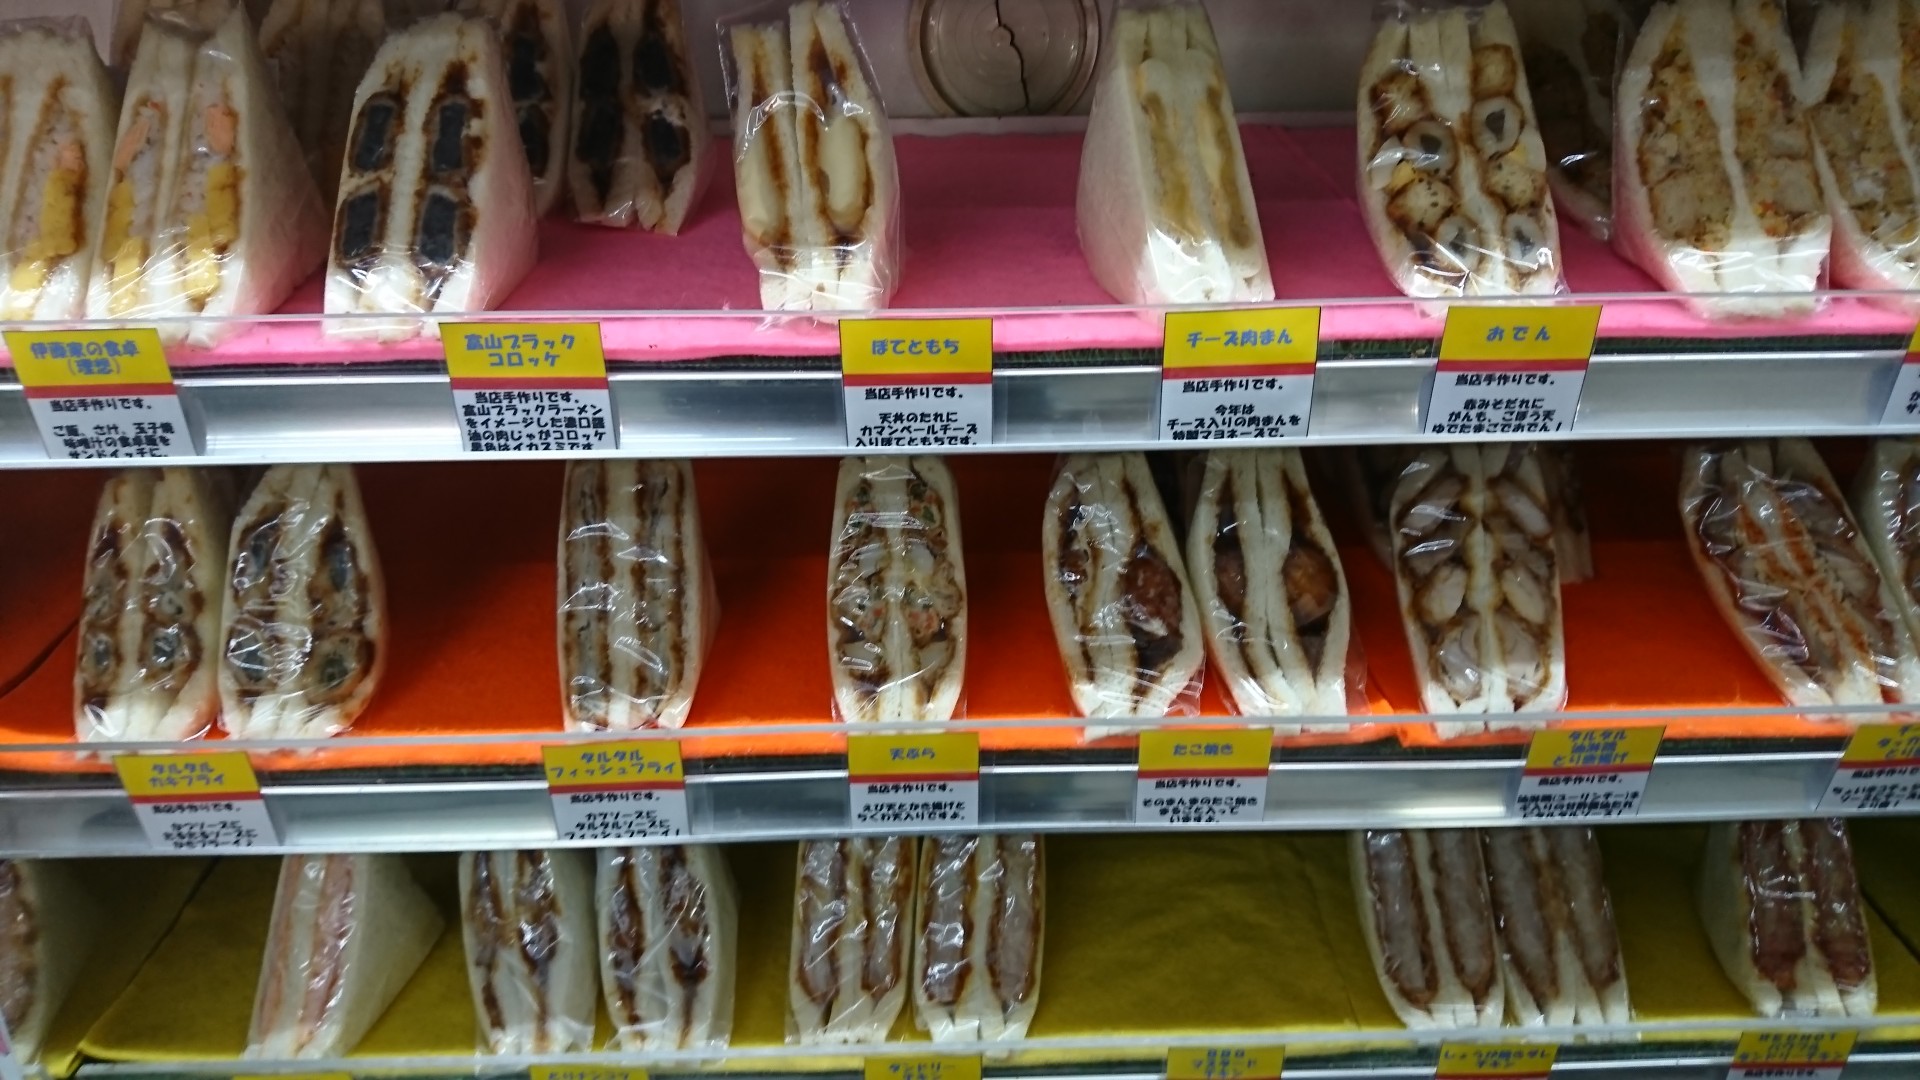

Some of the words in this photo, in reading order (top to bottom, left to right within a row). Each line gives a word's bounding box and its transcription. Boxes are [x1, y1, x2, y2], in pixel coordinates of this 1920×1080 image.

[1187, 329, 1293, 348] チーズ肉まん
[1487, 326, 1550, 342] おでん
[464, 334, 575, 350] 富山ブラック
[488, 352, 560, 367] コロッケ
[1182, 378, 1283, 393] 当店手作りです。
[1455, 374, 1555, 386] 当店手作りです。
[475, 391, 579, 404] 当店手作りです。
[865, 387, 963, 400] 当店手作りです。
[51, 399, 152, 412] 当店手作りです。
[463, 404, 603, 416] 富山ブラックラーメン
[1215, 404, 1255, 416] 今年は
[879, 412, 958, 423] 天丼のたれに
[1167, 415, 1301, 430] チーズ入りの肉まんを
[468, 429, 606, 441] 油の肉じゃがコロッケ
[860, 423, 978, 436] カマンベールチーズ
[1569, 730, 1627, 741] タルタル
[890, 748, 935, 760] 天ぷら
[1173, 743, 1233, 756] たこ焼き
[581, 750, 643, 764] タルタル
[550, 762, 675, 778] フィッシュフライ
[1155, 778, 1241, 789] 当店手作りです。
[1538, 775, 1623, 786] 当店手作りです。
[868, 783, 953, 794] 当店手作りです。
[570, 792, 660, 804] 当店手作りです。
[575, 819, 671, 831] タルタルソースに
